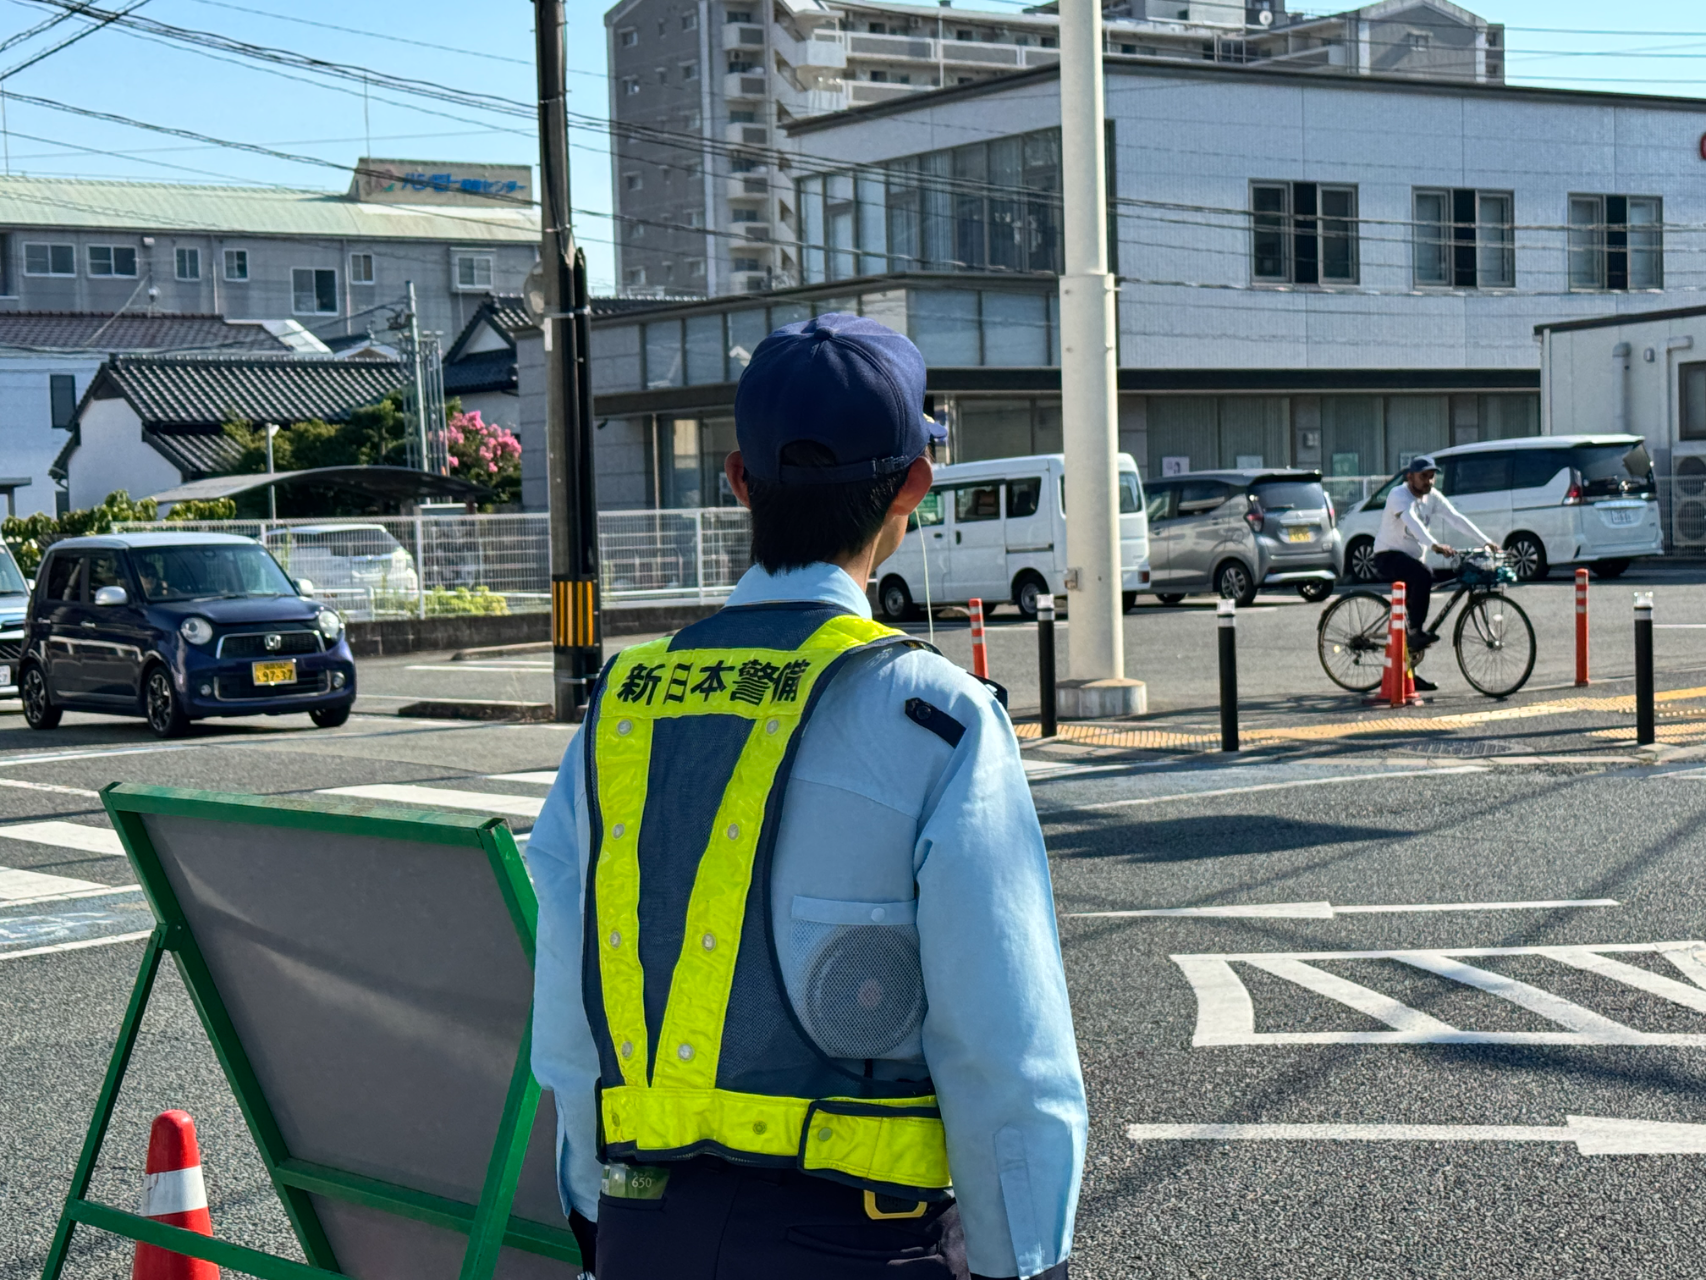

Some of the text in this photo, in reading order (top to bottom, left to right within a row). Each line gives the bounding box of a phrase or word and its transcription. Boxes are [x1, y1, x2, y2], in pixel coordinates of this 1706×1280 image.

[616, 658, 811, 706] 新日本警備
[631, 1176, 652, 1188] 650
